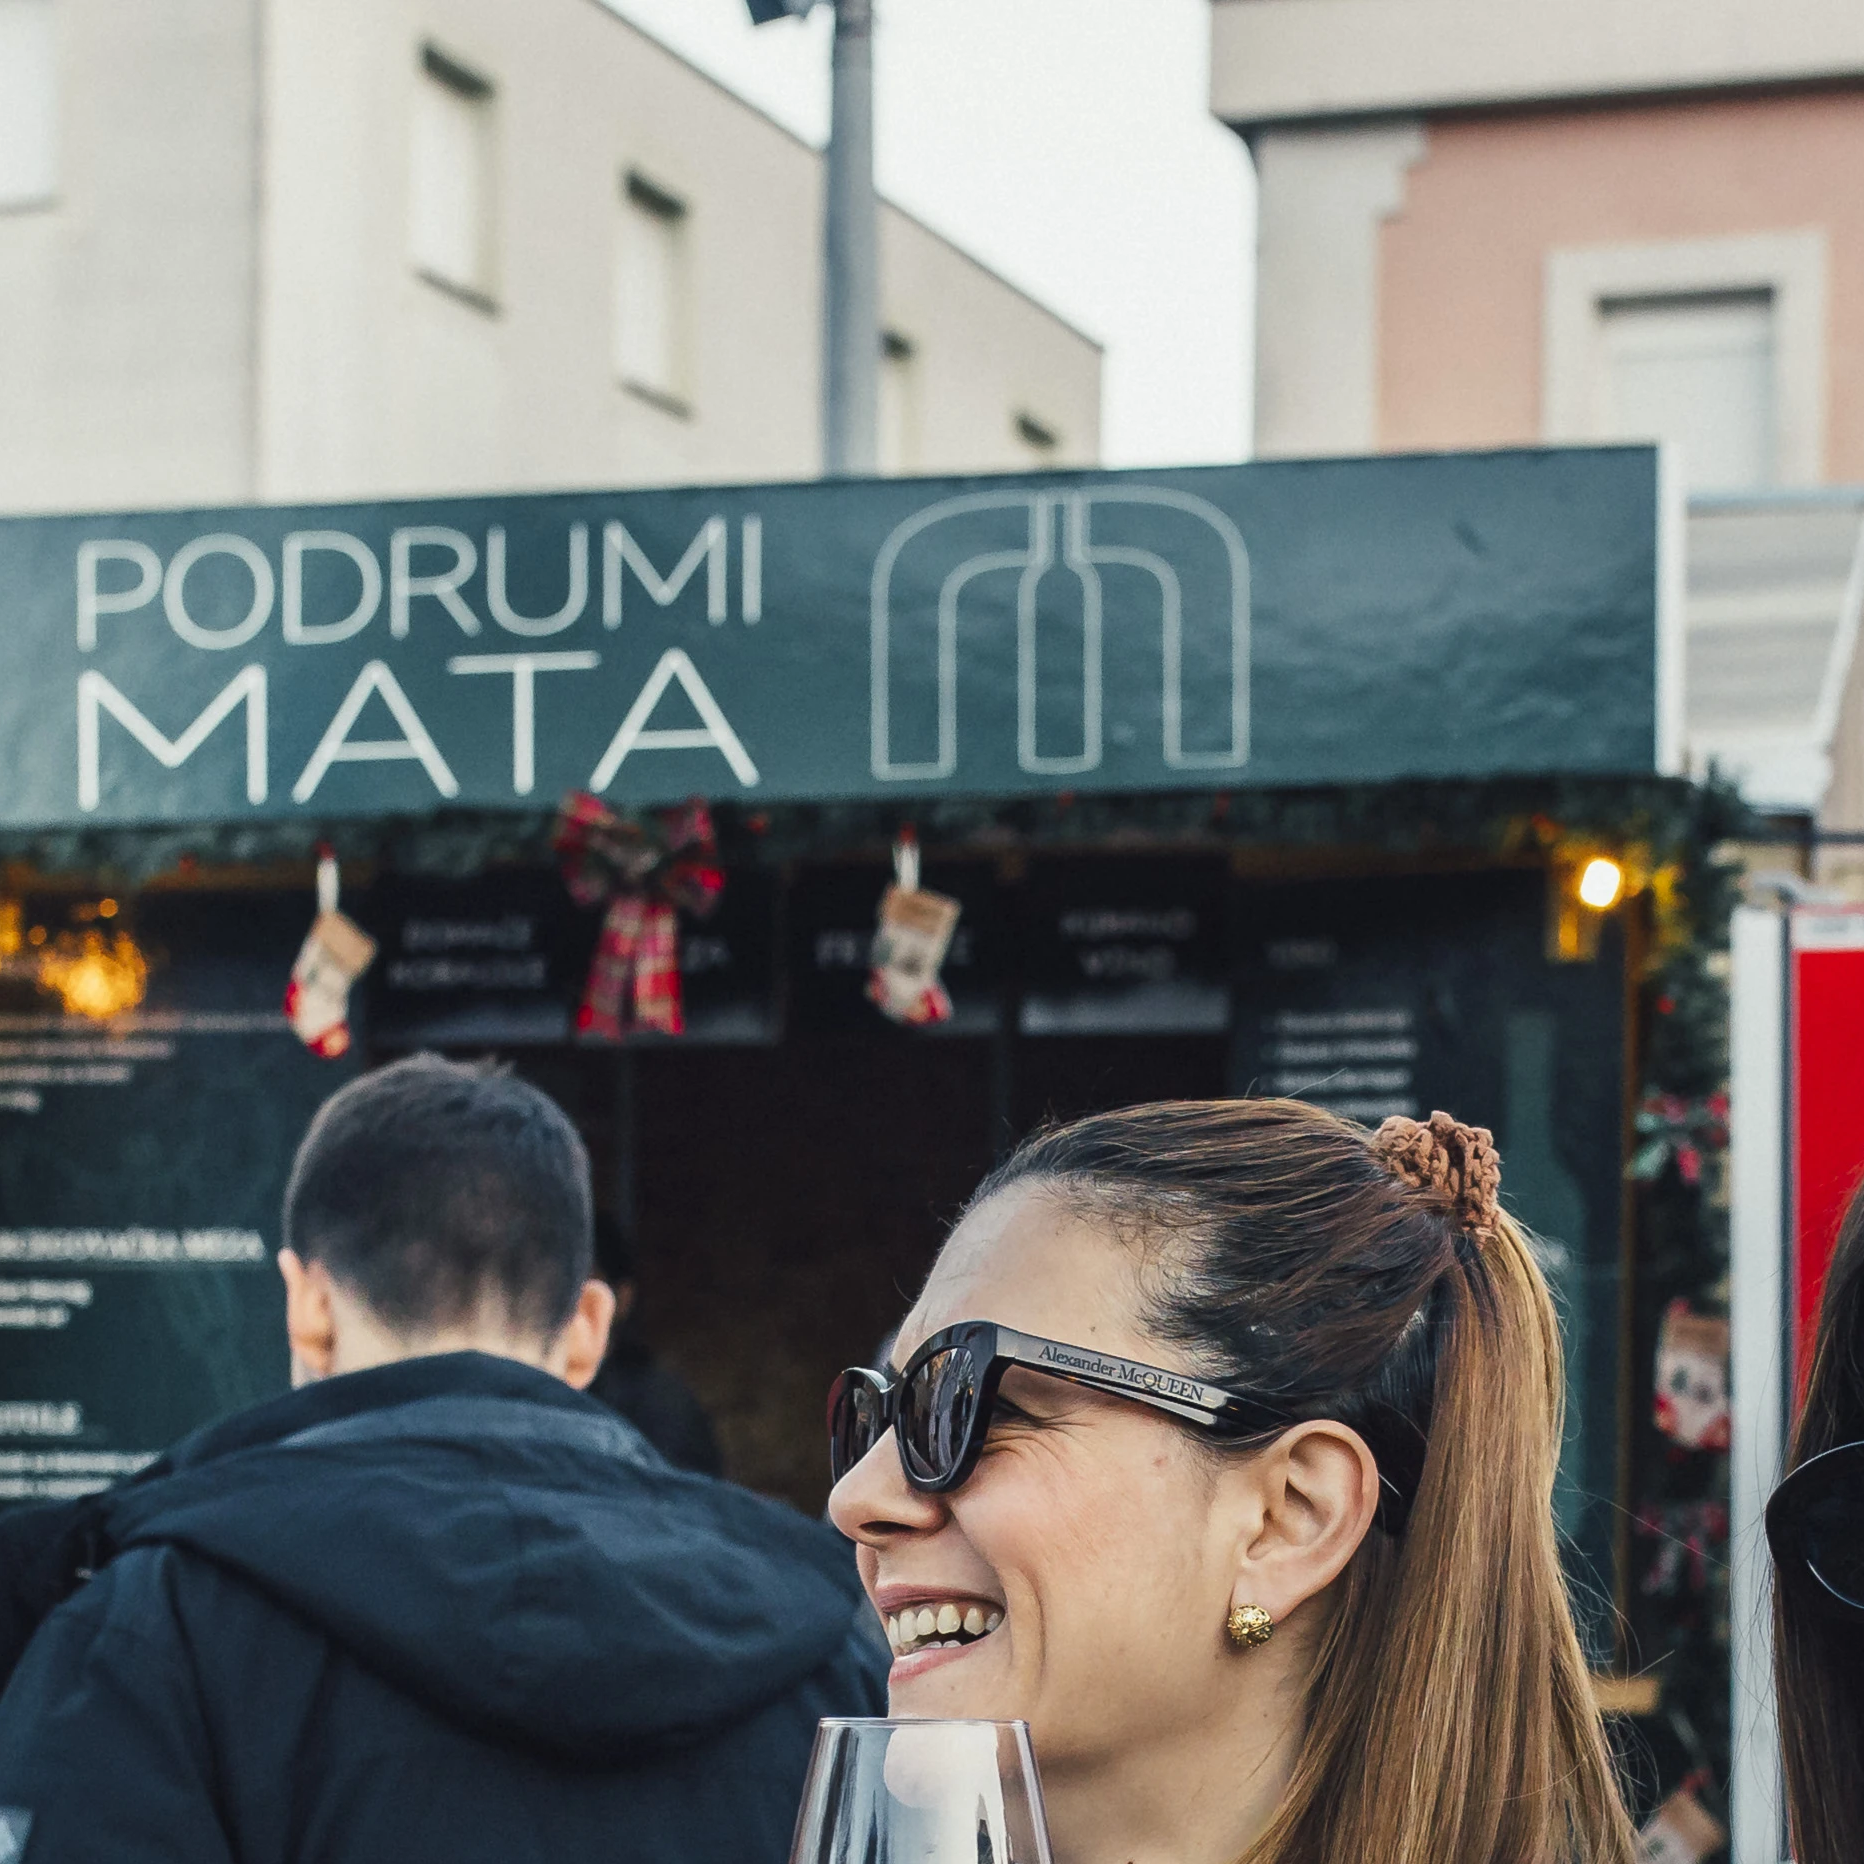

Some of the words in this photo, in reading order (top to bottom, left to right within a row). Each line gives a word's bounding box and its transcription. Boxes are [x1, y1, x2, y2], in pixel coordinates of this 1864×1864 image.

[76, 514, 764, 654] PODRUMI
[76, 645, 762, 812] MATA
[1039, 1345, 1116, 1377] Alexander
[1118, 1364, 1204, 1402] McQUEEN
